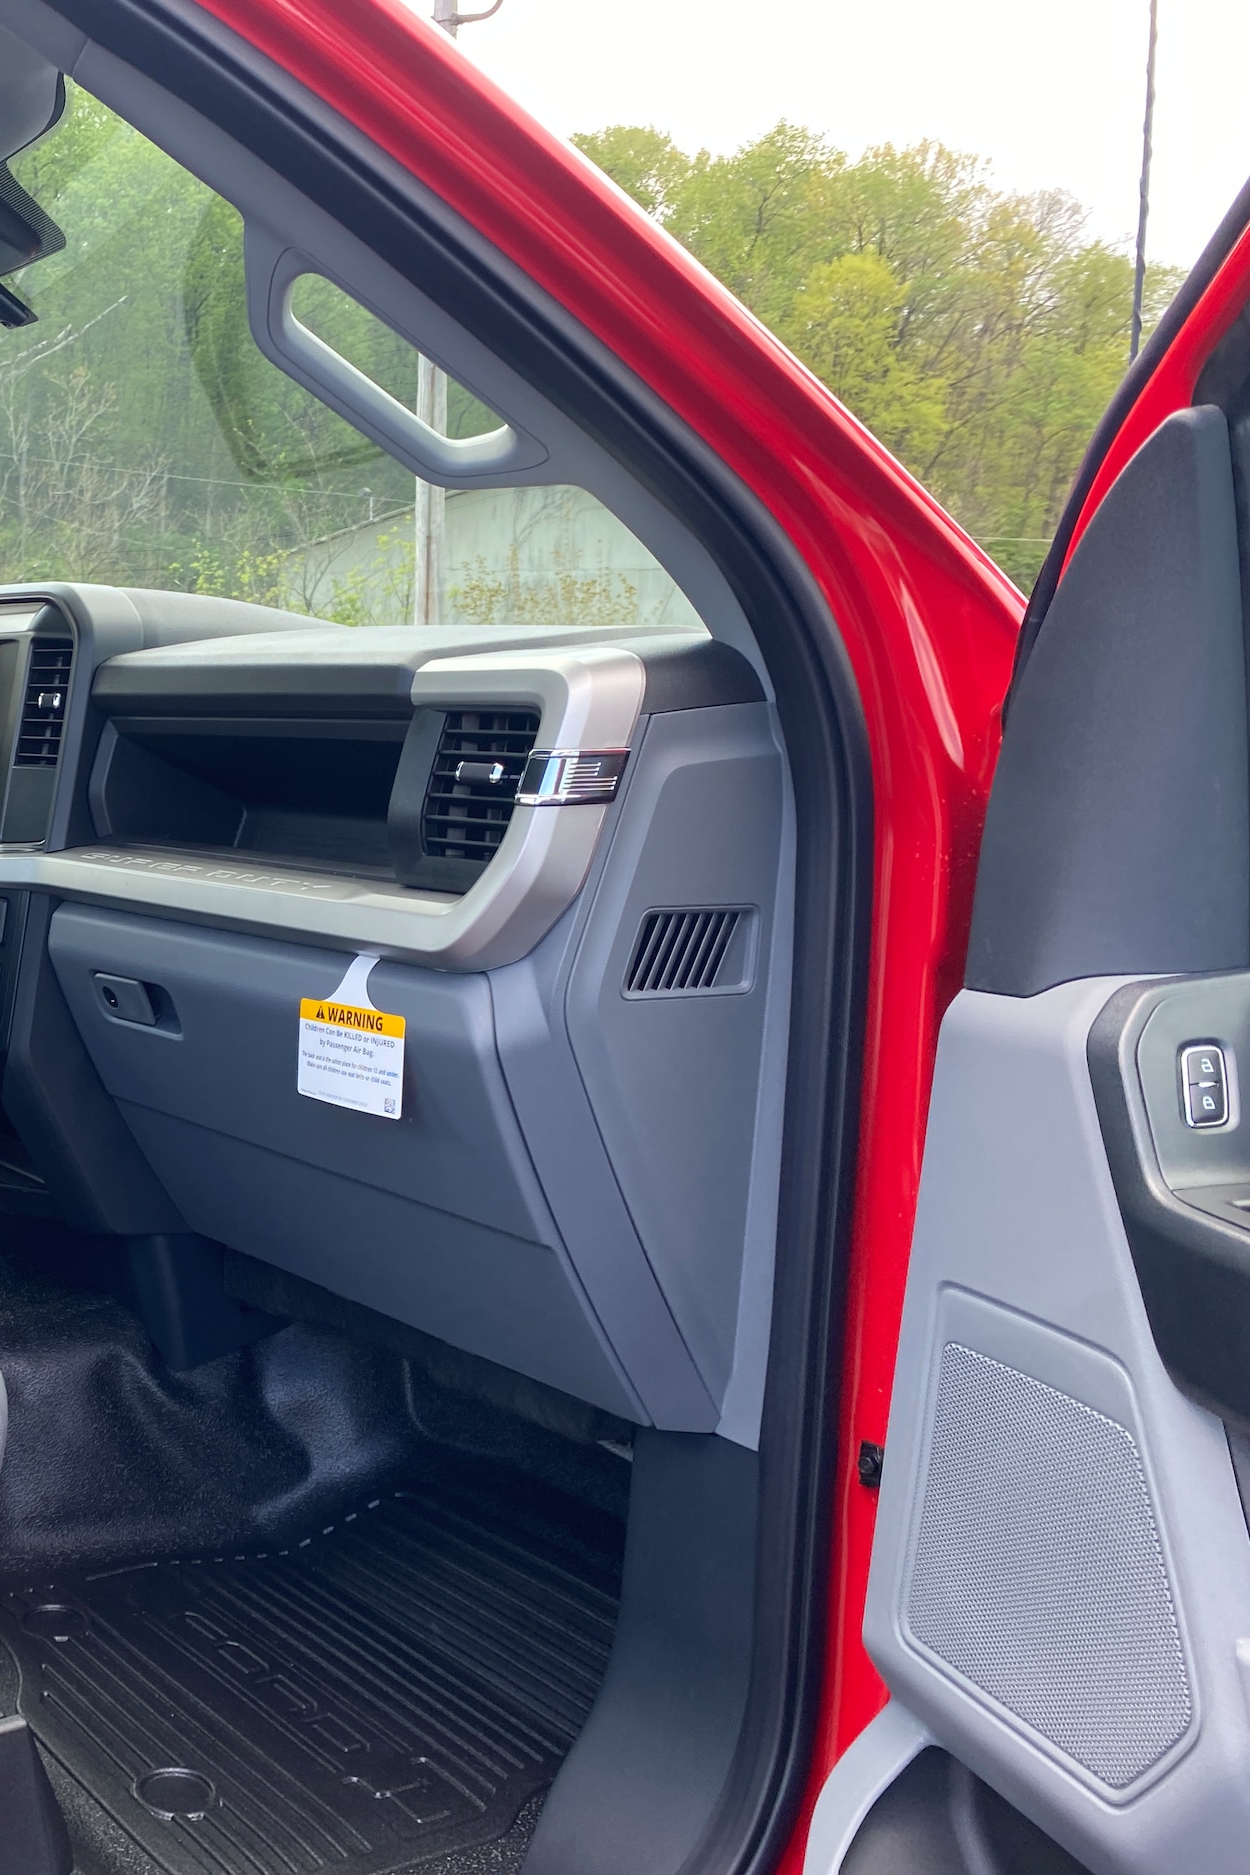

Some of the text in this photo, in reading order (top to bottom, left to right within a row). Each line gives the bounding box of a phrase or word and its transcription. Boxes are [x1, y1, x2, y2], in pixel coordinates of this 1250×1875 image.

[80, 852, 332, 891] SUPER DUTY
[327, 1005, 383, 1032] WARNING
[304, 1022, 325, 1034] Children
[325, 1027, 336, 1036] Can
[336, 1029, 343, 1038] Be
[344, 1031, 363, 1042] KILLED
[370, 1036, 396, 1049] INJURED
[319, 1038, 327, 1048] by
[326, 1039, 353, 1053] Passenger
[353, 1045, 362, 1054] Air
